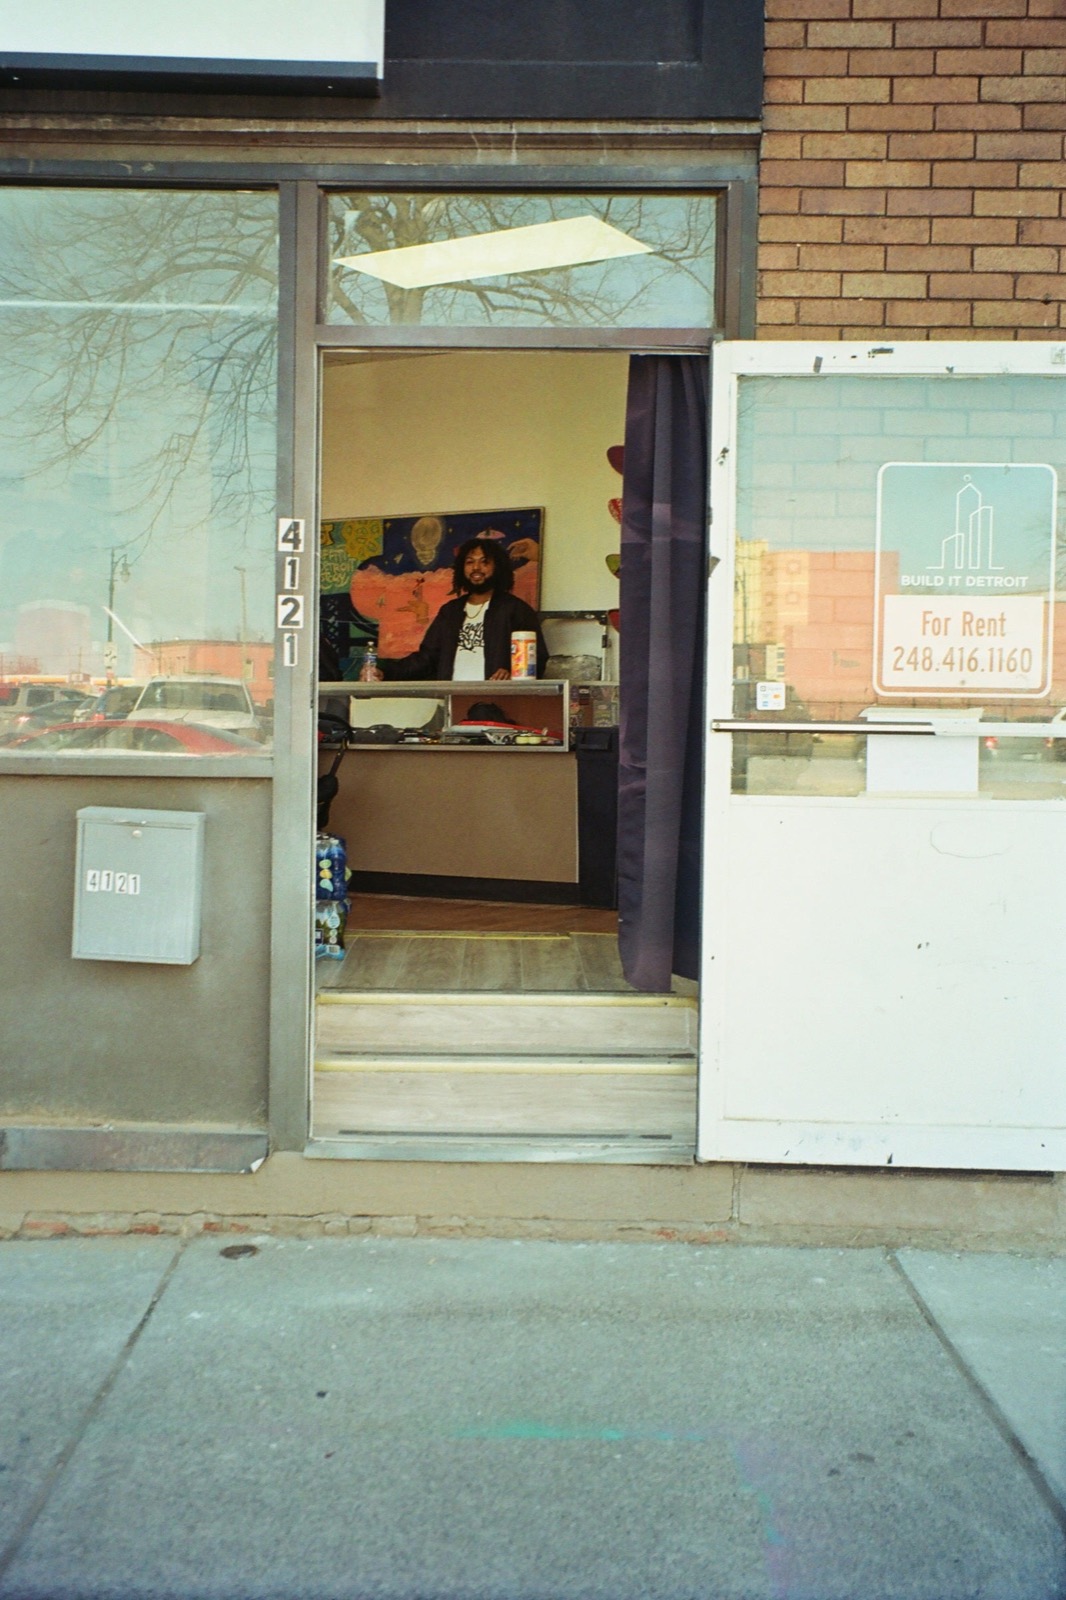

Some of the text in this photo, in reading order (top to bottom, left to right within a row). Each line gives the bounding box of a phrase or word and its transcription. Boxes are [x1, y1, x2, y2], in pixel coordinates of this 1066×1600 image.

[281, 521, 302, 665] 4121
[901, 575, 1029, 587] BUILD IT DETROIT
[921, 610, 1006, 637] For Rent
[892, 646, 1032, 673] 248.416.1160
[88, 872, 138, 893] 4121
